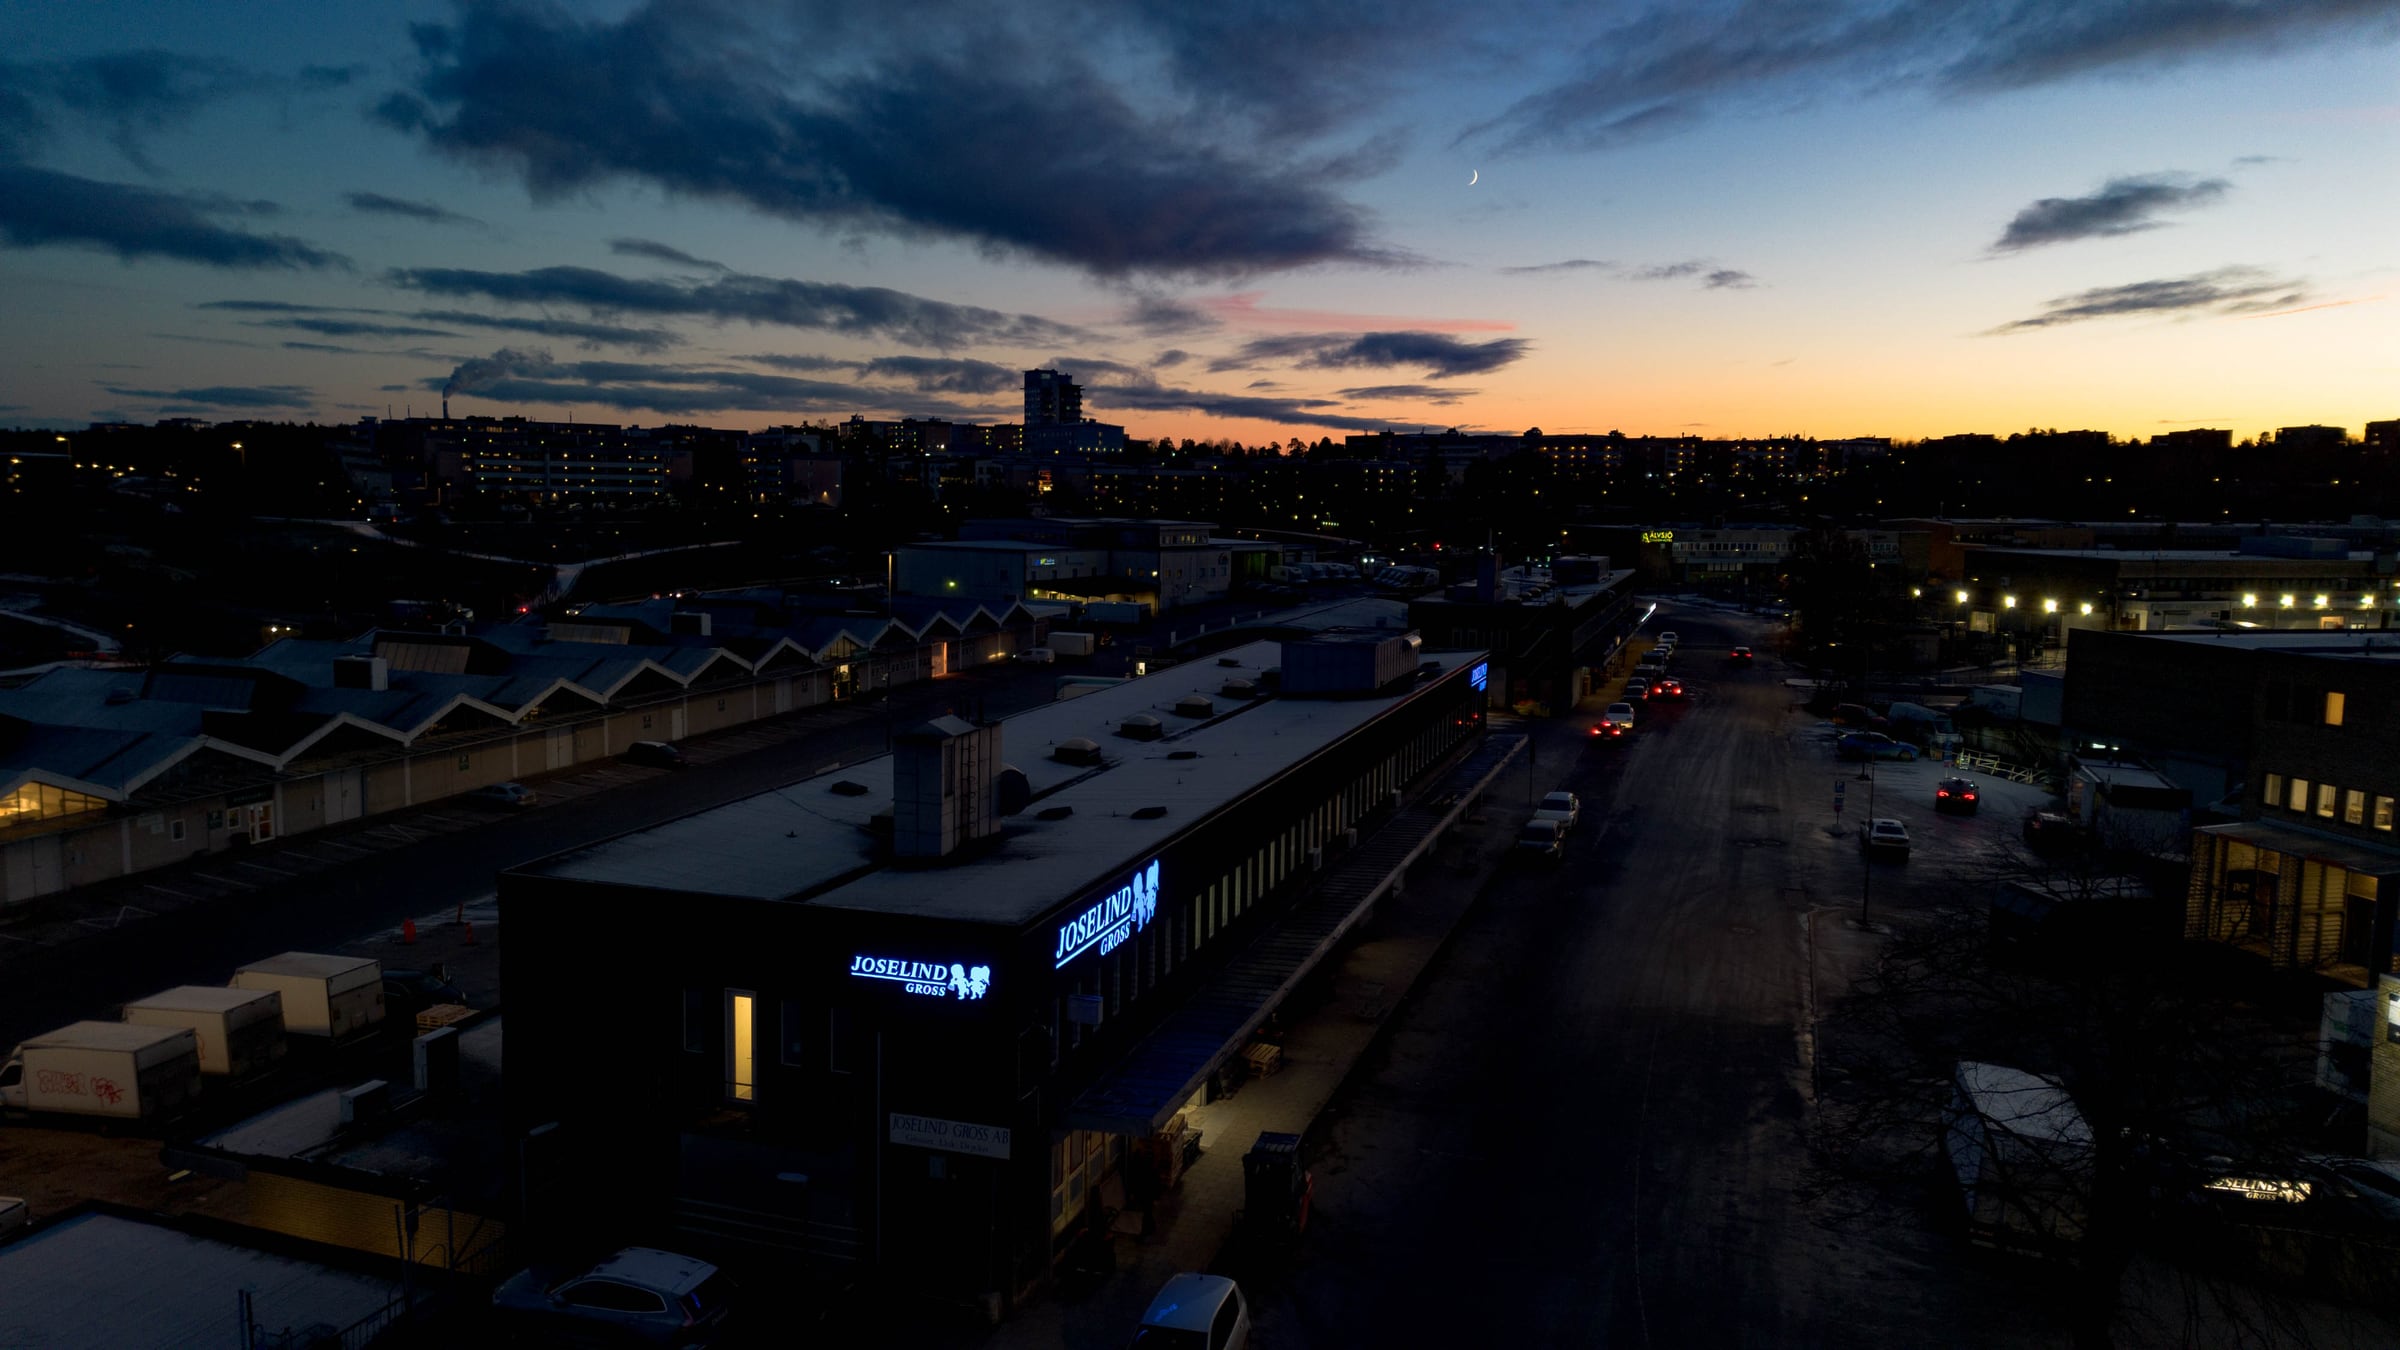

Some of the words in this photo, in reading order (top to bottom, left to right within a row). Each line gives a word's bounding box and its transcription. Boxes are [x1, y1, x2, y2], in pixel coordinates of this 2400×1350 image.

[1057, 886, 1131, 959] JOSELIND
[1100, 922, 1130, 956] GROSS
[851, 956, 947, 981] JOSELIND
[905, 983, 946, 997] GROSS
[892, 1114, 947, 1136] JOSELIND
[952, 1124, 989, 1142] GROSS
[992, 1130, 1009, 1145] AB
[2246, 1192, 2277, 1201] GROSS
